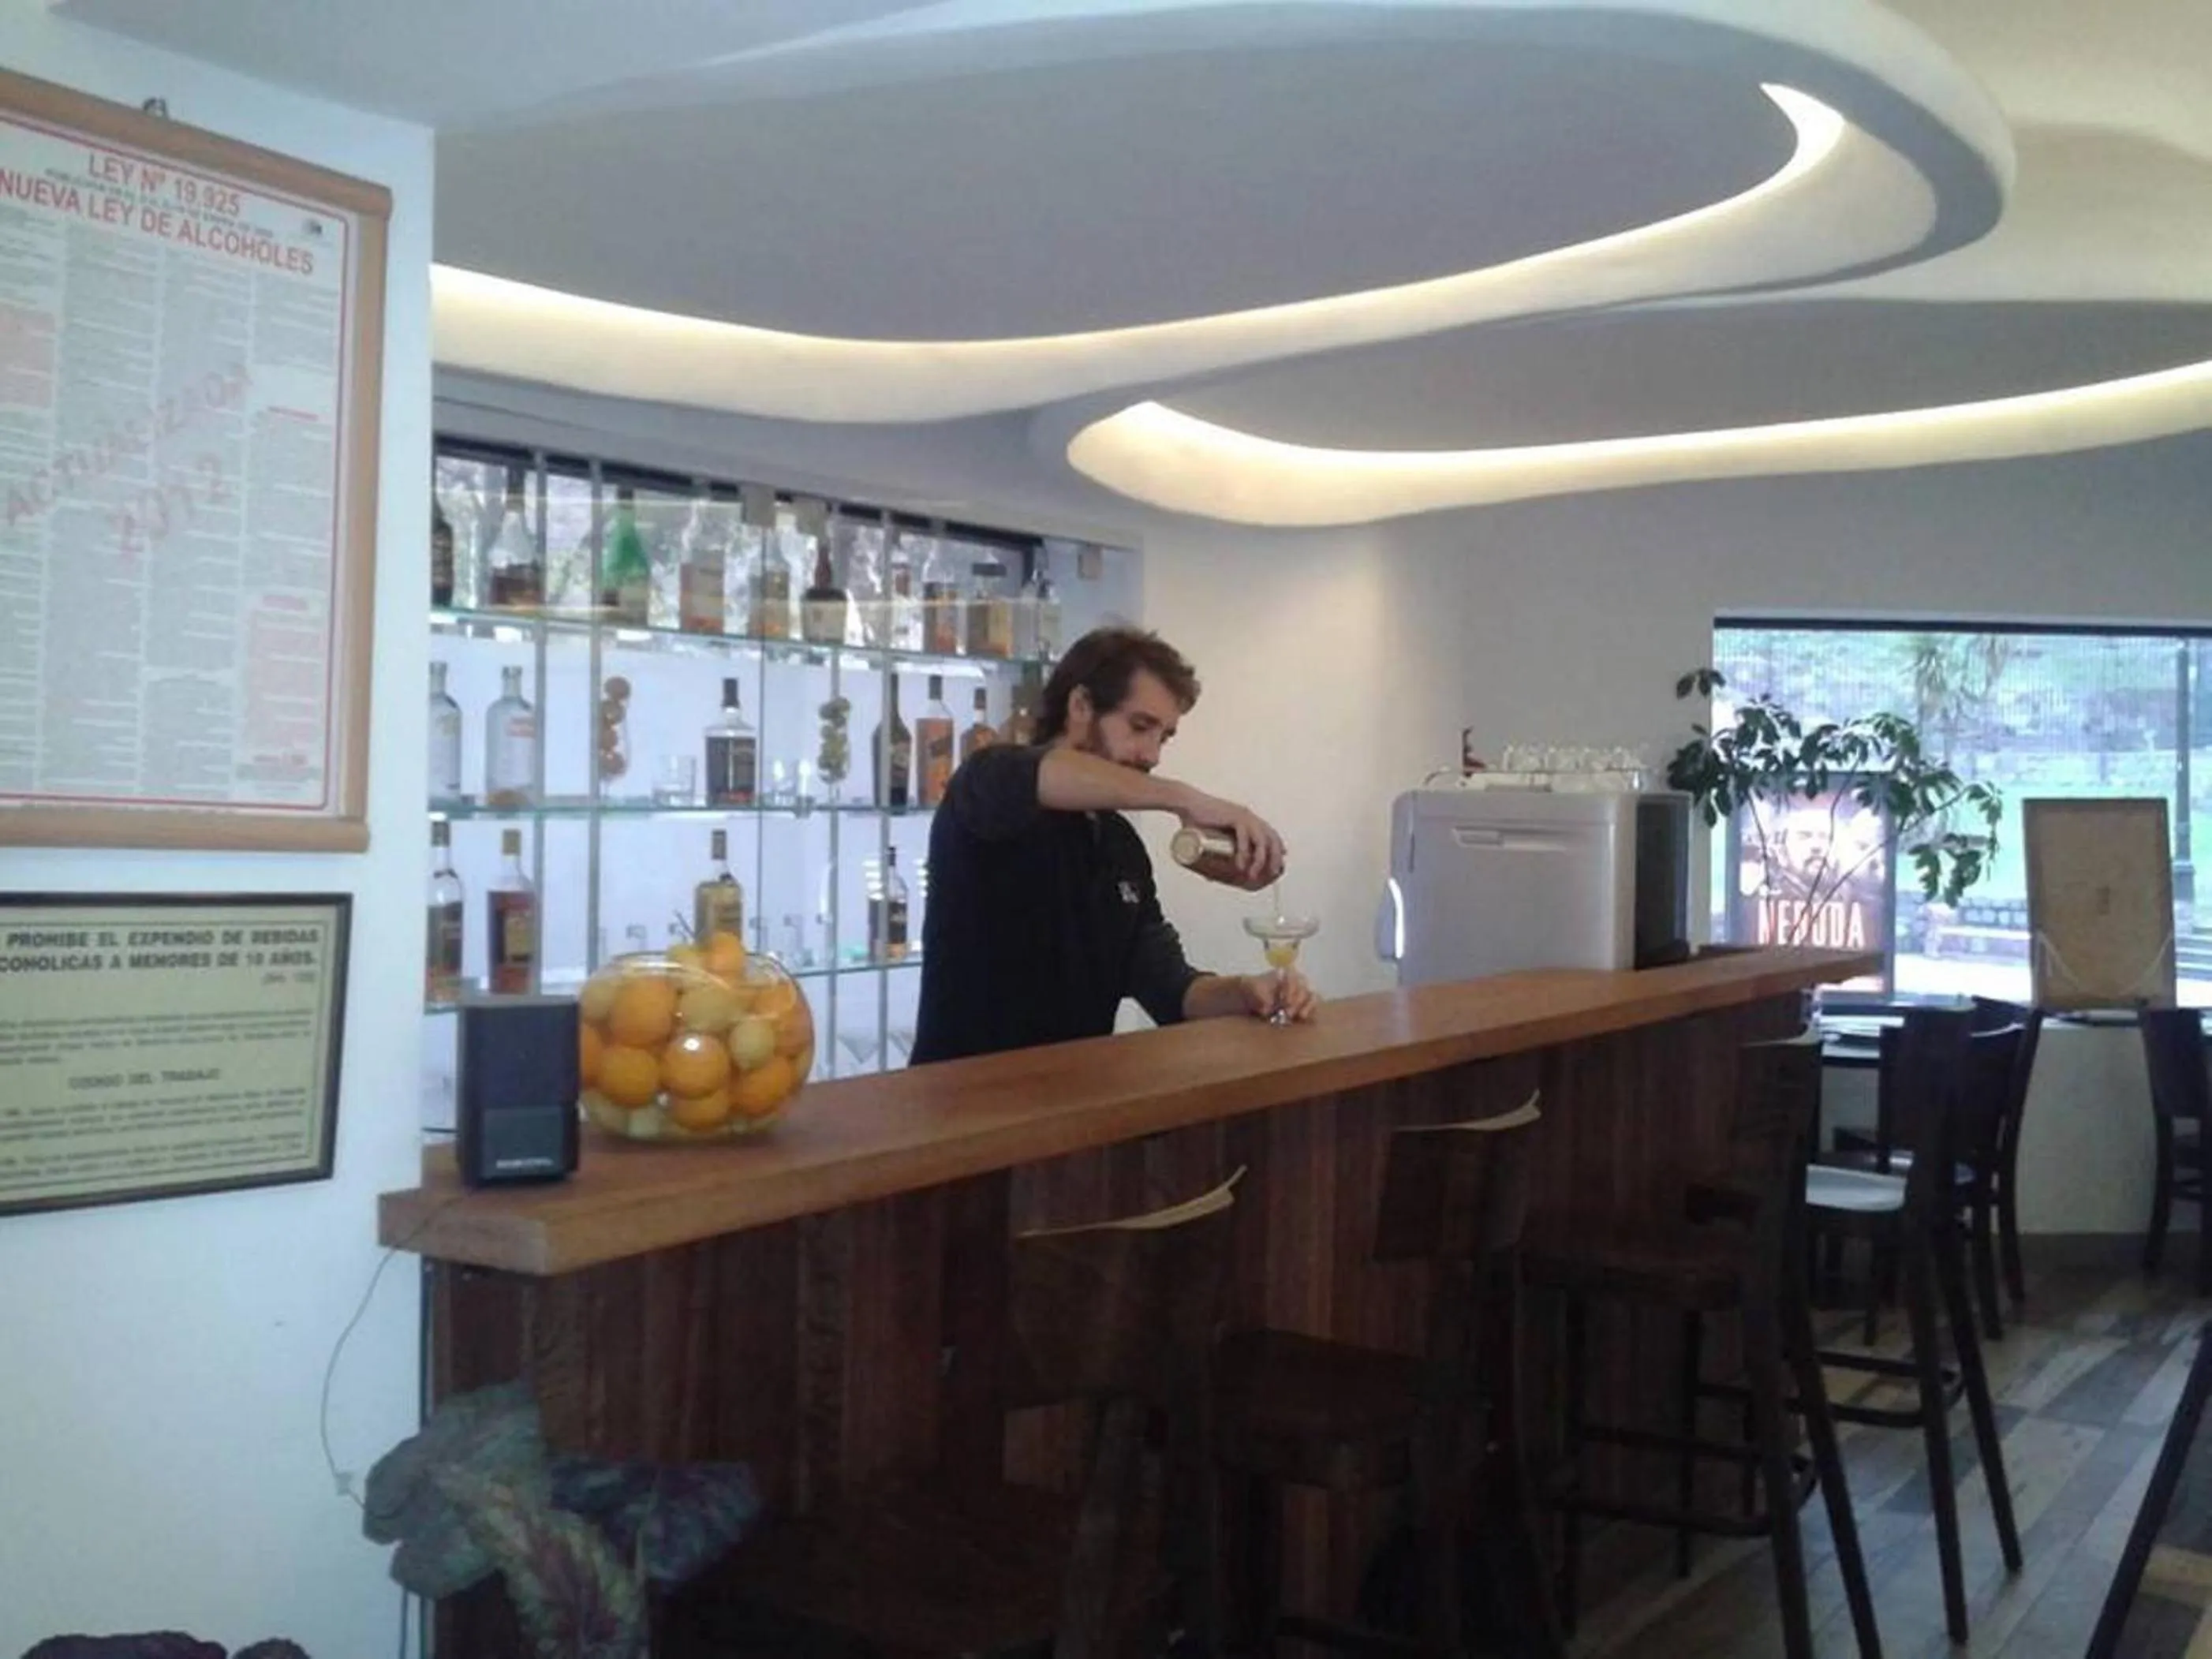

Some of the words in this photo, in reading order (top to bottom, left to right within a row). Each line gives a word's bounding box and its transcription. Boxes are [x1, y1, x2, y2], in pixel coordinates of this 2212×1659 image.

[88, 154, 136, 183] LEY
[0, 169, 80, 212] NUEVA
[88, 196, 135, 226] LEY
[140, 206, 173, 237] DE
[175, 219, 315, 275] ALCOHOLES
[6, 931, 88, 947] PROHIBE
[97, 931, 120, 946] EL
[128, 930, 215, 946] EXPENDIO
[222, 929, 244, 945] DE
[251, 929, 319, 945] BEBIDAS
[109, 953, 121, 970] A
[129, 952, 211, 970] MENORES
[217, 951, 238, 968] DE
